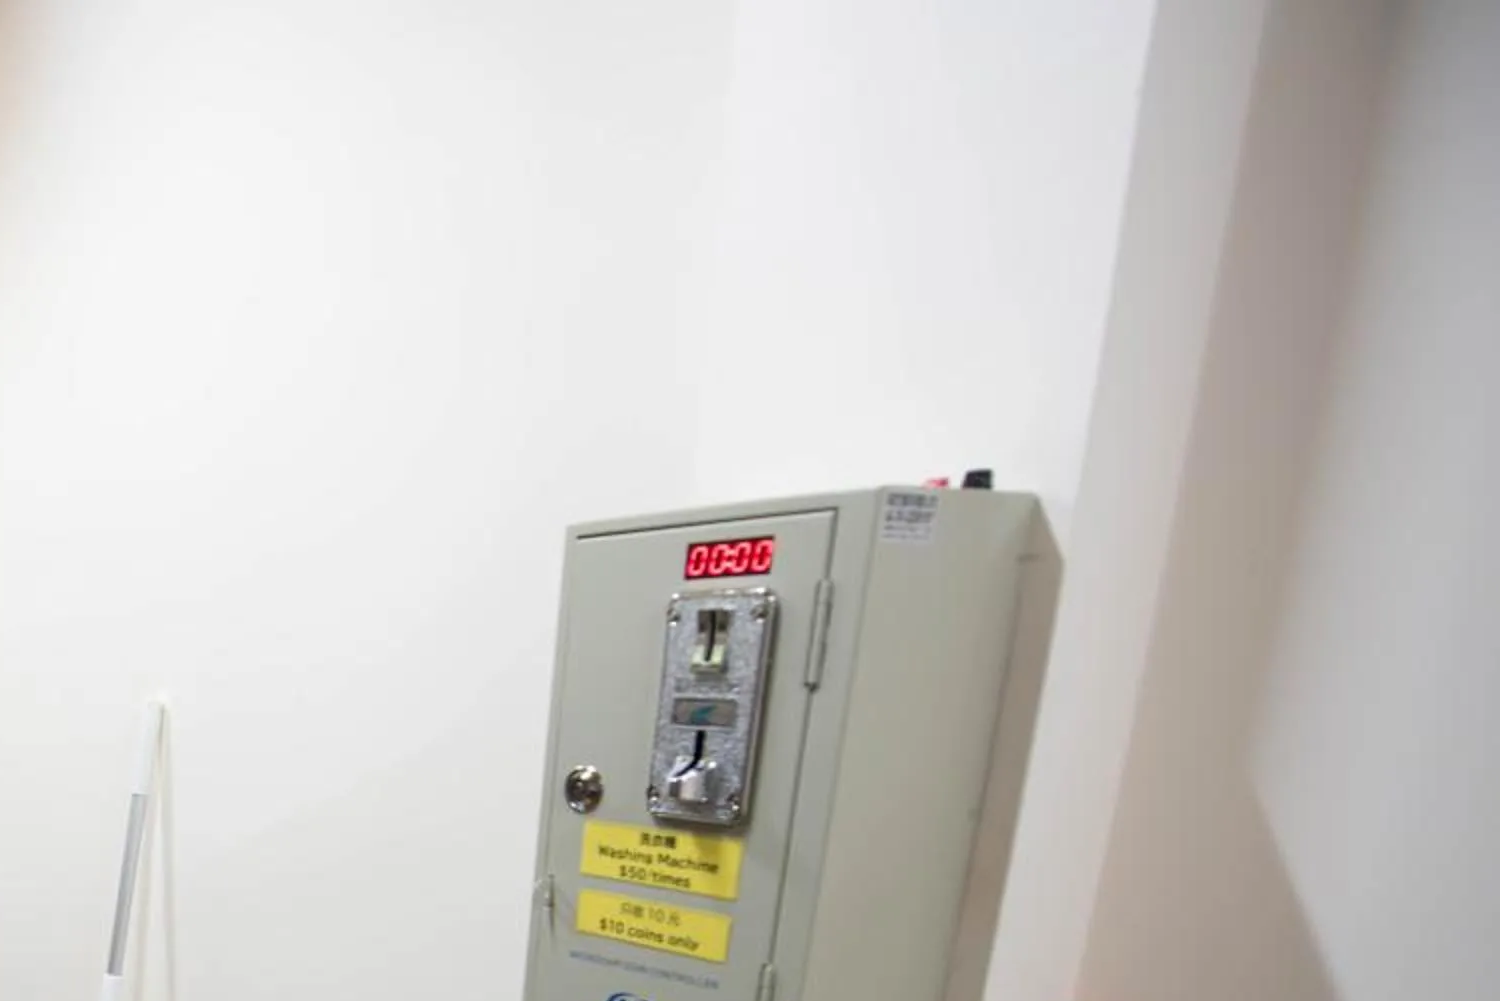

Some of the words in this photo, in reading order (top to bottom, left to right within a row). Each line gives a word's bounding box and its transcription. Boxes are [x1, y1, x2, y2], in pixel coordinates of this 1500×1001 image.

[687, 539, 773, 578] 00:00
[598, 845, 653, 864] Washing
[657, 853, 719, 874] Machine
[599, 917, 625, 935] $10
[628, 927, 664, 943] coins
[667, 935, 700, 951] only
